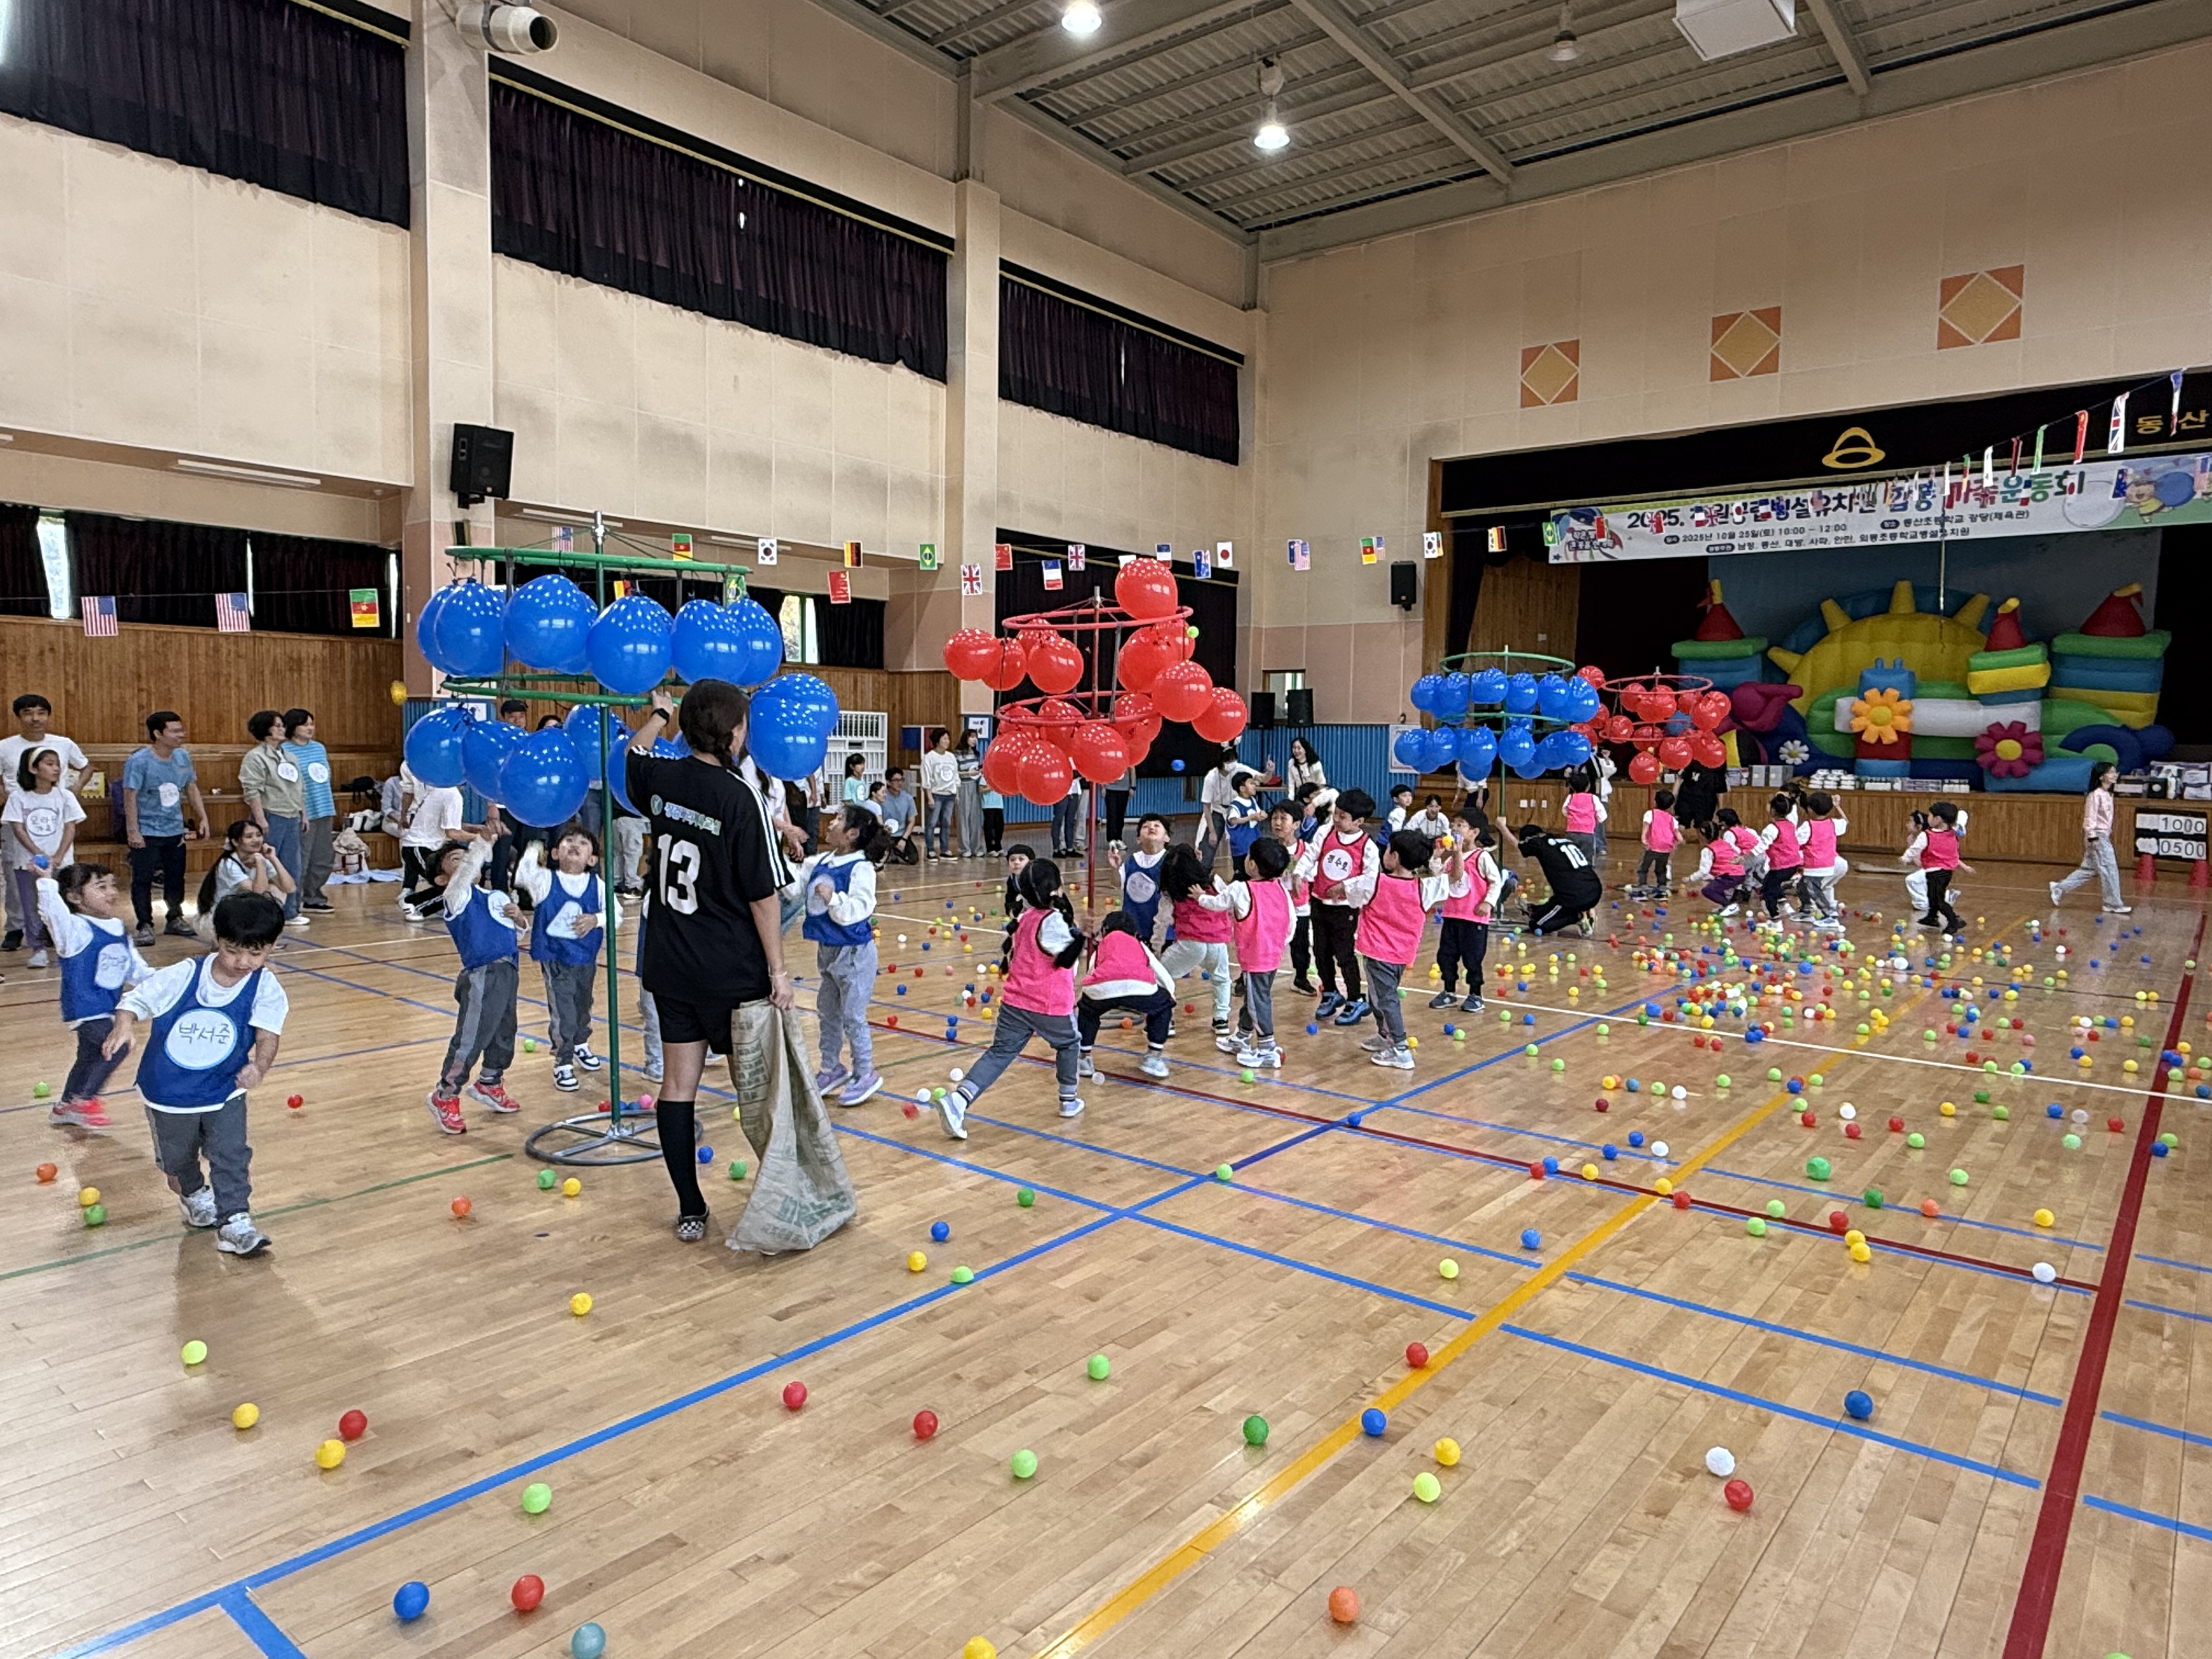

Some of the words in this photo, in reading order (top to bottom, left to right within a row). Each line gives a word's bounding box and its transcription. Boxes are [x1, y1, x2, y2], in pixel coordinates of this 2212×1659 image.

[1682, 533, 1713, 542] 2025년
[1717, 531, 1736, 540] 10월
[1779, 527, 1805, 535] 10:00
[1819, 523, 1847, 533] 12:00
[2162, 816, 2205, 833] 1000
[1559, 844, 1589, 869] 10
[2160, 840, 2205, 858] 0500
[657, 833, 701, 915] 13
[179, 1022, 231, 1044] 박서준
